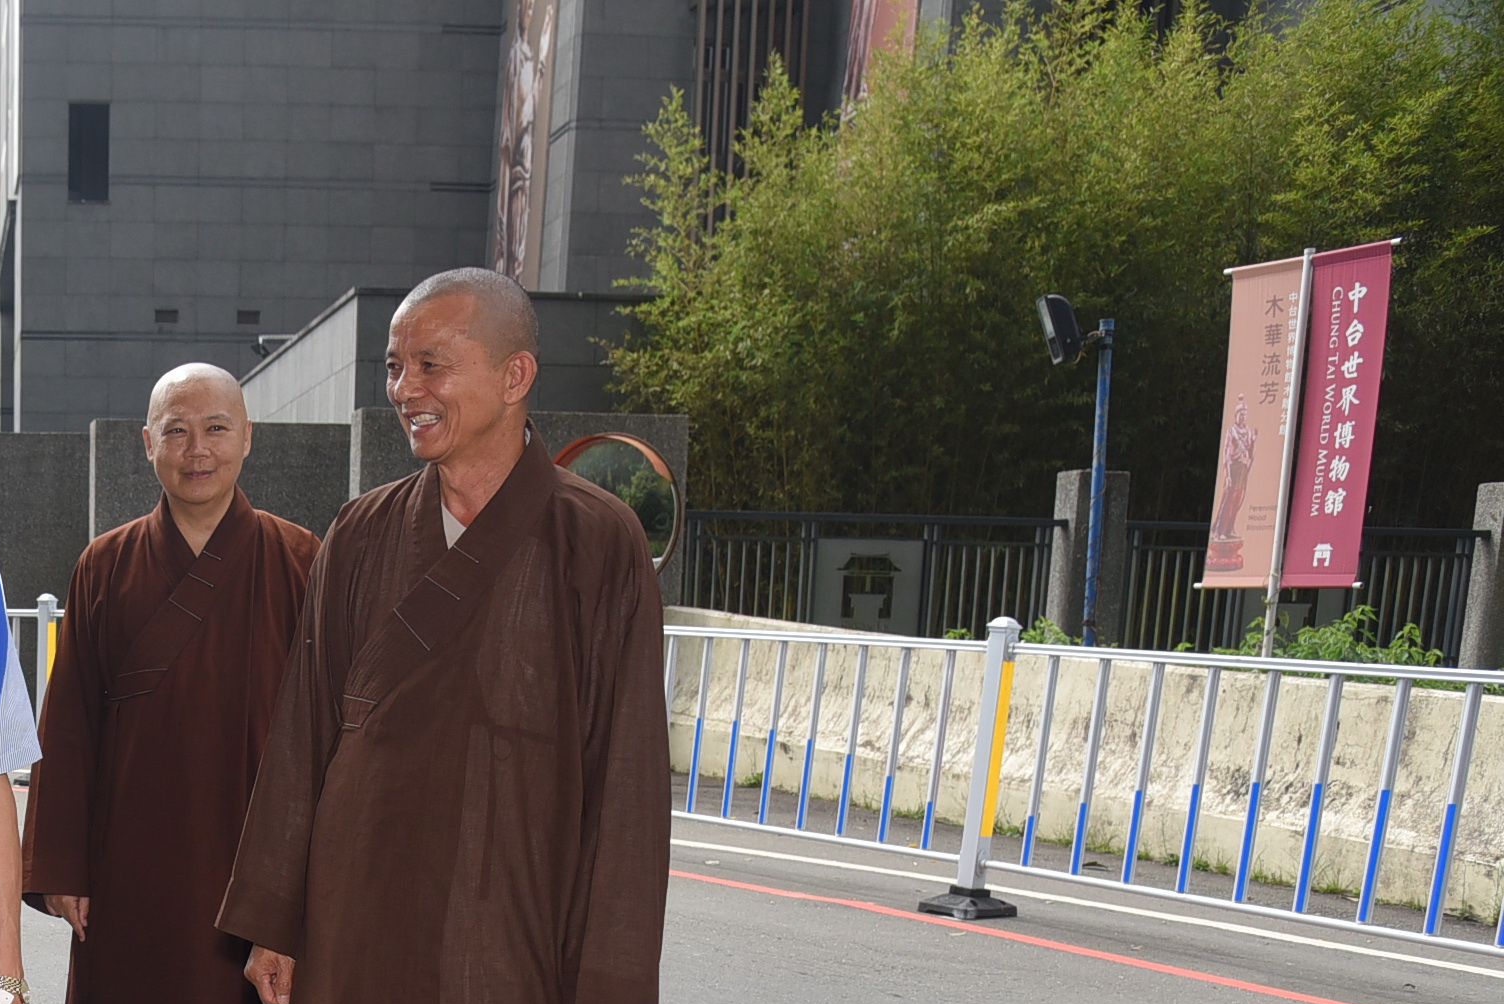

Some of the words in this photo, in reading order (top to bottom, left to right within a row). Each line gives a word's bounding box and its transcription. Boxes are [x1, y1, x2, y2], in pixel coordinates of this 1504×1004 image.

[1329, 286, 1344, 349] CHUNG
[1258, 294, 1284, 406] 木華流芳
[1326, 352, 1339, 380] TAI
[1319, 383, 1336, 445] WORLD
[1310, 448, 1329, 517] MUSEUM
